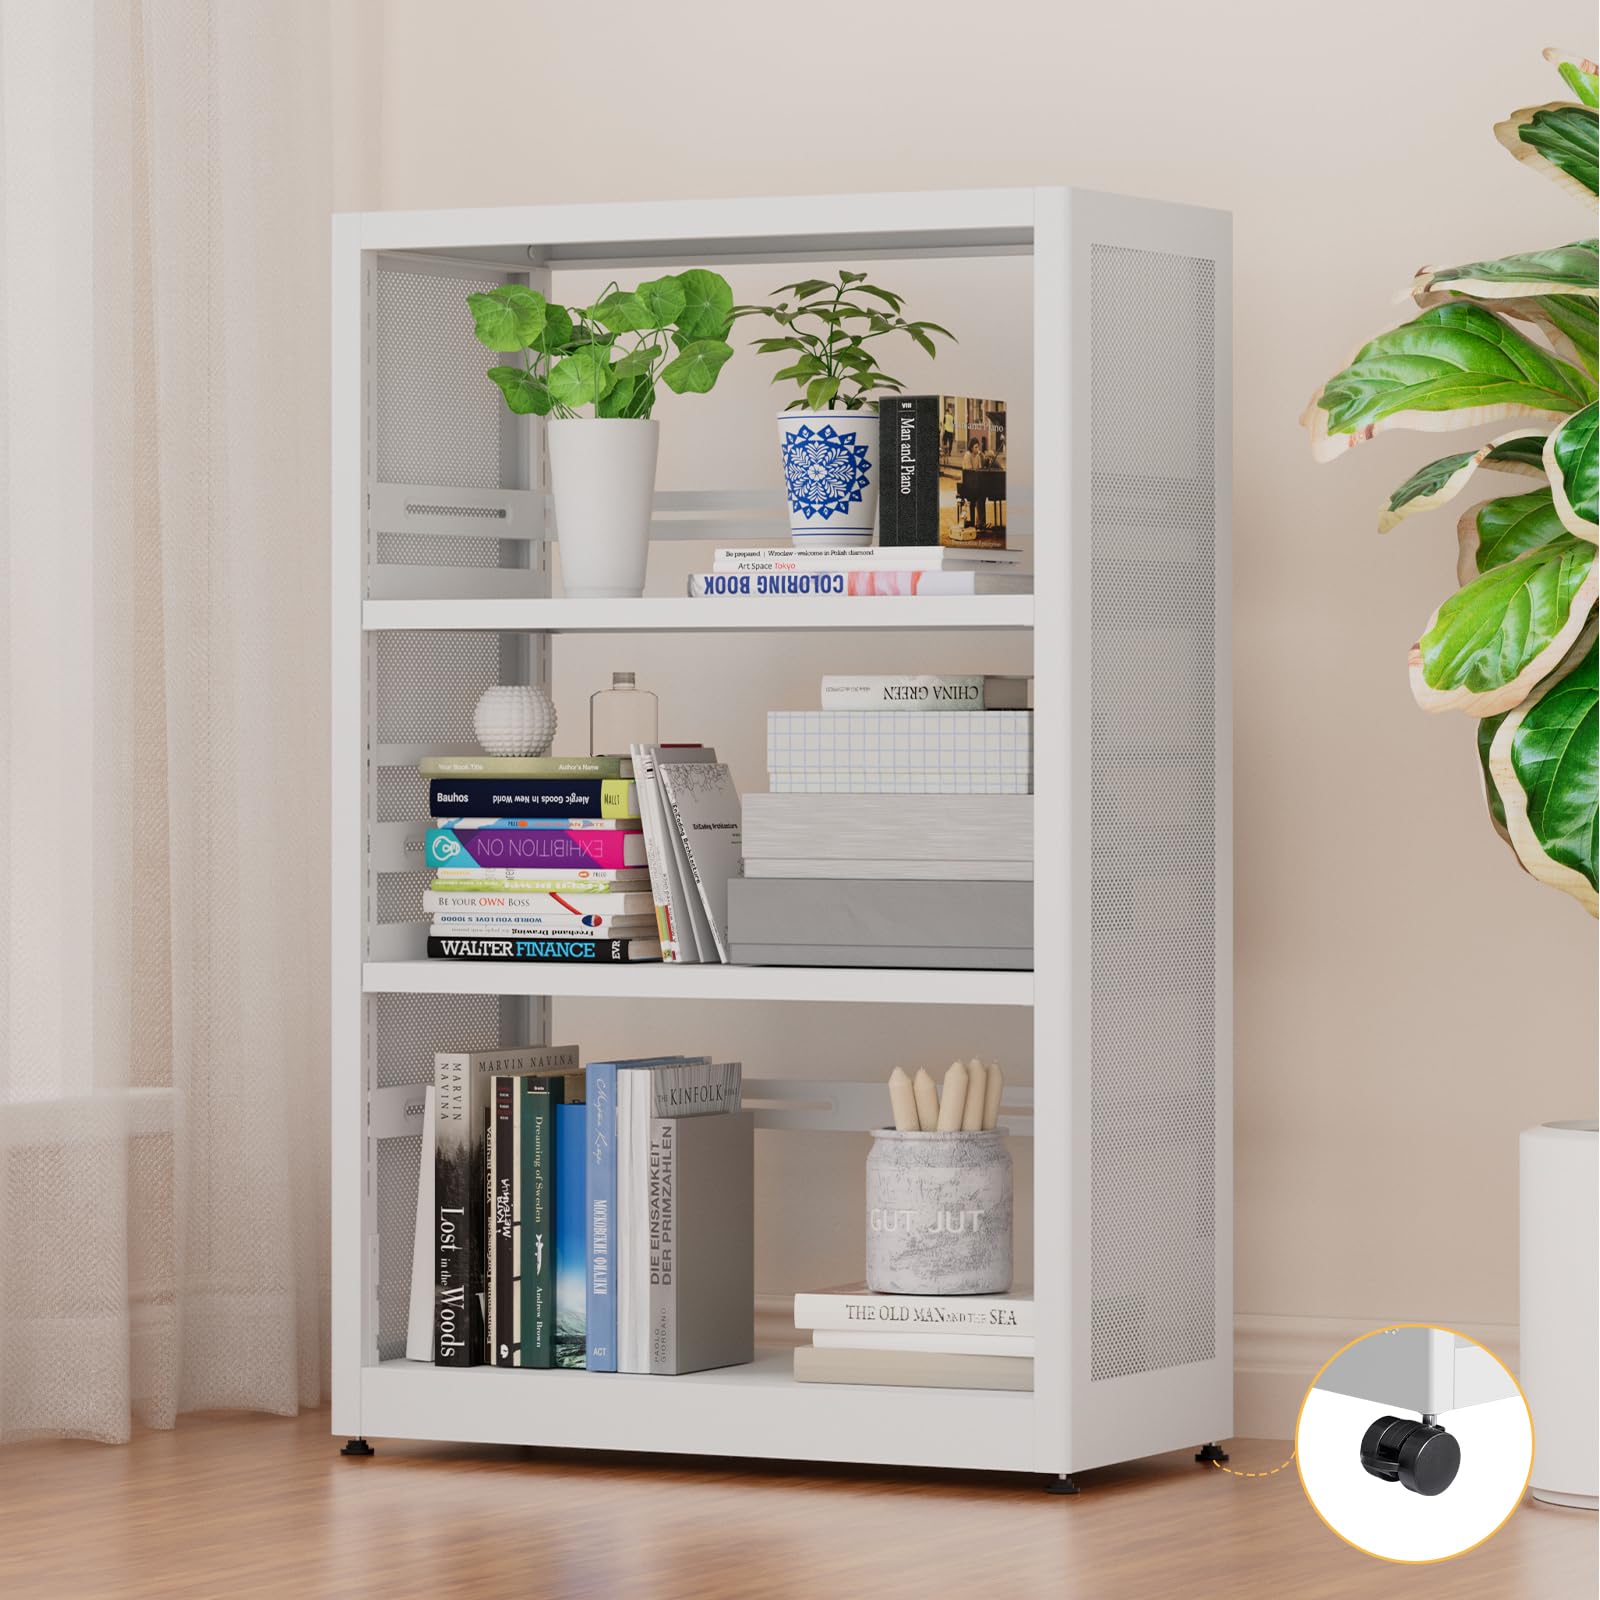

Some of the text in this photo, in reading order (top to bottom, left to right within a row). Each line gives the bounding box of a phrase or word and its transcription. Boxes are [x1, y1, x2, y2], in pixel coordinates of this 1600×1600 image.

[900, 418, 916, 495] Man and Piano
[751, 563, 773, 571] Space
[704, 574, 844, 595] COLORING BOOK
[883, 686, 929, 701] GREEN
[932, 685, 979, 700] CHINA
[558, 763, 582, 771] Author's
[436, 792, 469, 803] Bauhos
[492, 793, 590, 805] Alergic Goods In New World
[477, 838, 603, 858] EXHIBITION ON
[438, 898, 449, 906] BE
[450, 898, 477, 906] YOUR
[479, 898, 505, 907] OWN
[511, 928, 549, 937] Drawing
[551, 929, 594, 937] Freehand
[440, 940, 596, 958] WALTER FINANCE
[611, 940, 621, 960] EVR
[478, 1054, 574, 1073] MARVIN NAVINA
[440, 1063, 449, 1120] NAVINA
[452, 1063, 462, 1121] MARVIN
[670, 1084, 723, 1106] KINFOLK
[534, 1116, 543, 1223] Dreaming of Sweden
[650, 1140, 660, 1285] DIE EINSAMKEIT
[662, 1126, 672, 1286] DER PRIMZAHLEN
[869, 1208, 985, 1233] GUT JUT
[593, 1199, 608, 1295] МОСКОВСКИЕ ФИАЛКИ
[440, 1205, 466, 1357] Lost in the Woods
[535, 1286, 543, 1348] Andrew Brown
[846, 1304, 876, 1320] THE
[879, 1305, 910, 1321] OLD
[913, 1306, 946, 1323] MAN
[989, 1309, 1017, 1326] SEA
